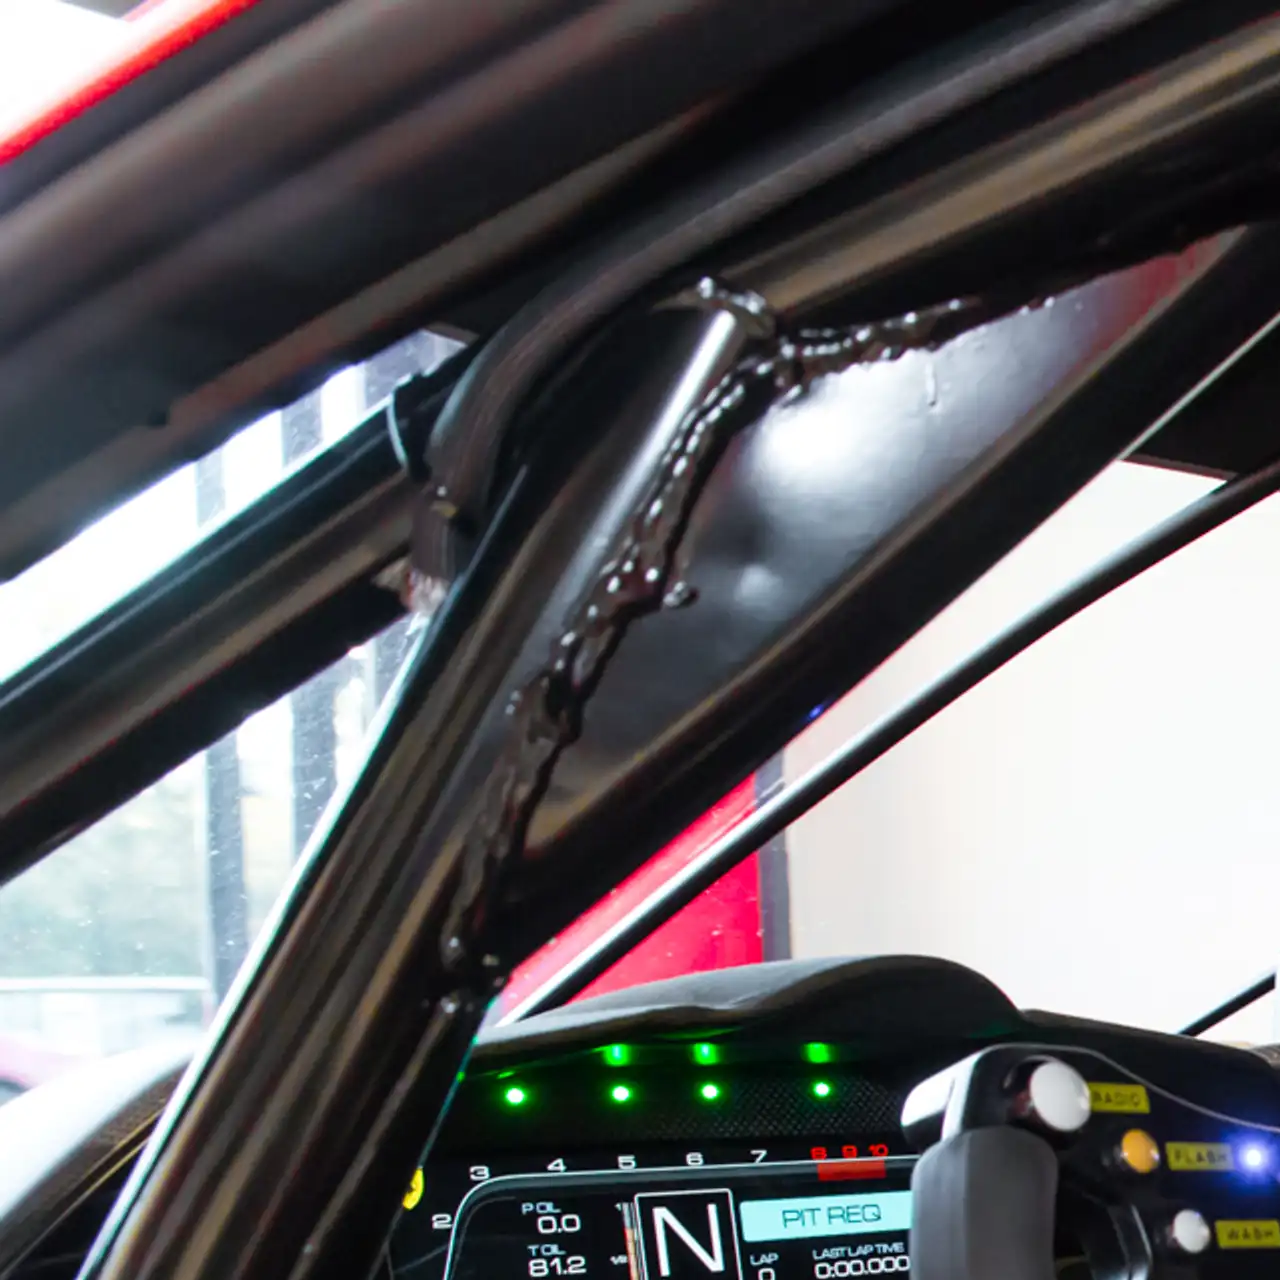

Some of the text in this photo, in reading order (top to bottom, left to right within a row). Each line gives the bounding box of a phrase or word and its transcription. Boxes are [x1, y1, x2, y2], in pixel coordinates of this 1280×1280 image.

[432, 1213, 452, 1229] 2
[469, 1166, 490, 1181] 3
[547, 1158, 567, 1172] 4
[617, 1155, 637, 1170] 5
[685, 1152, 703, 1166] 6
[750, 1150, 768, 1163] 7
[868, 1143, 889, 1158] 10
[522, 1202, 562, 1216] P OIL
[781, 1203, 883, 1229] PIT REQ
[537, 1214, 581, 1234] 0.0
[527, 1244, 567, 1258] T OIL
[652, 1203, 725, 1278] N
[750, 1253, 779, 1267] LAP
[812, 1242, 905, 1261] LAST LAP TIME
[527, 1256, 587, 1278] 81.2
[814, 1255, 911, 1280] 0:00.000
